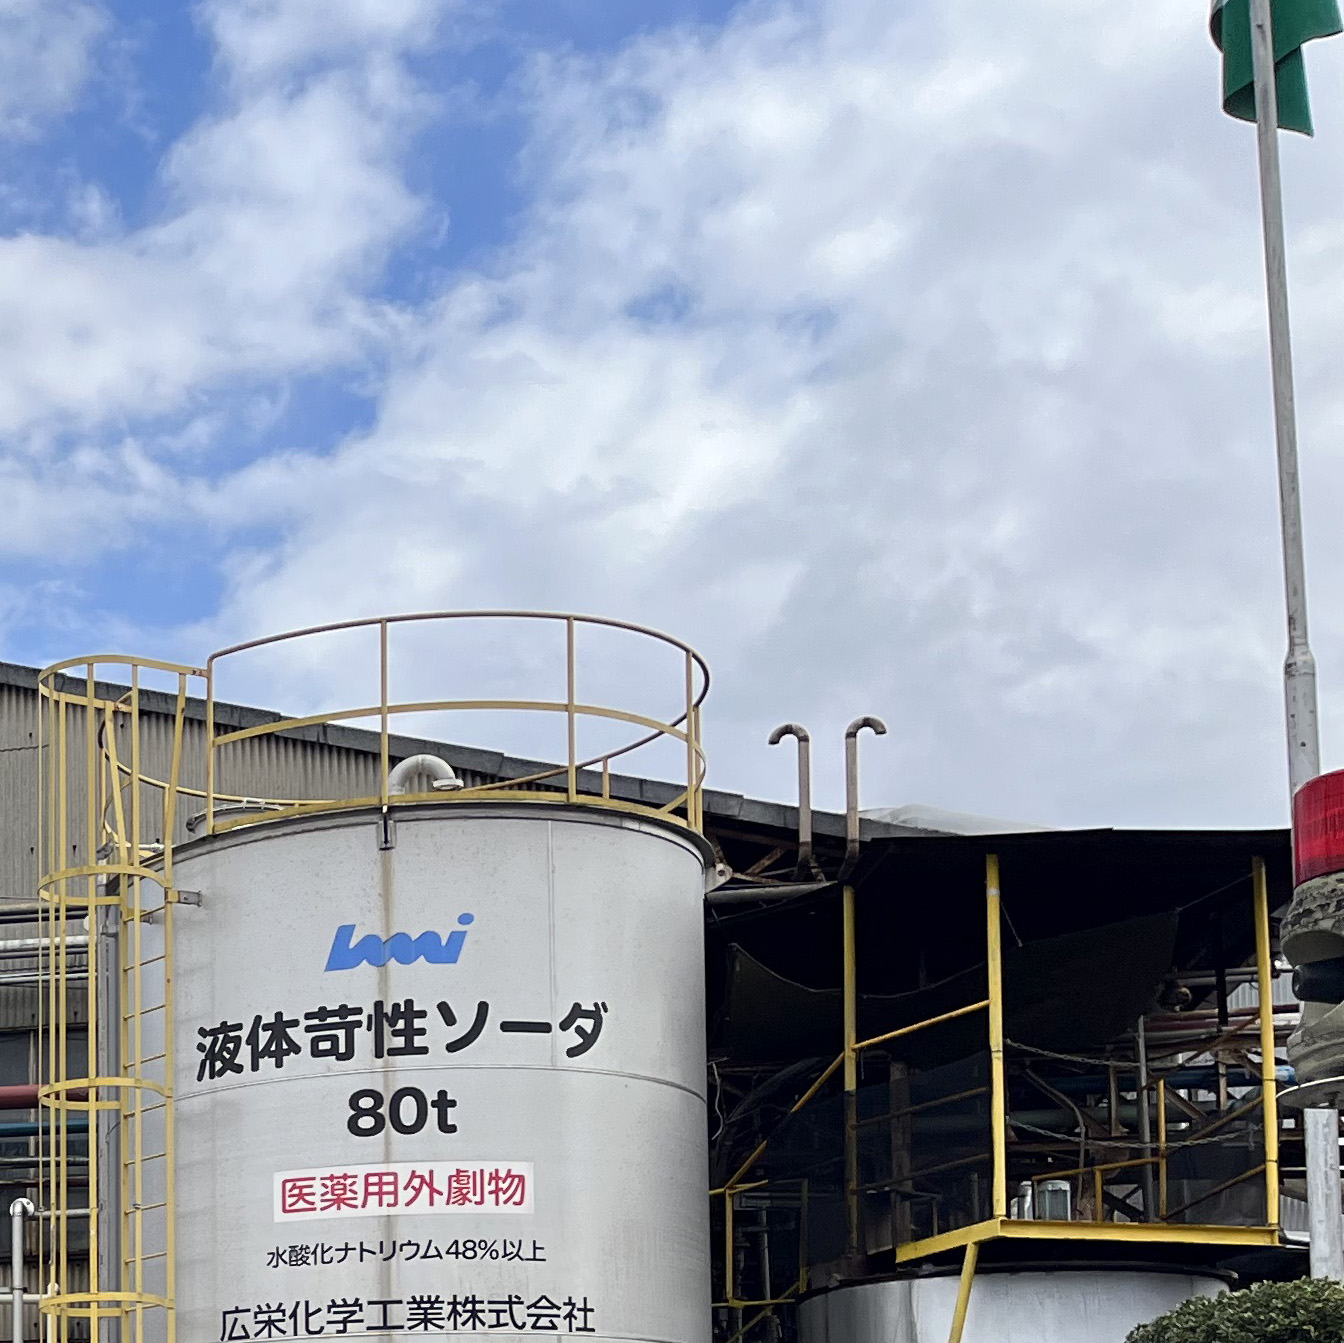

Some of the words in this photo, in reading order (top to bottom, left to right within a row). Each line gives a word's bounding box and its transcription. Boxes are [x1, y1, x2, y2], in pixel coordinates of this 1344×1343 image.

[196, 998, 608, 1082] 液体苛性ソーダ
[347, 1087, 458, 1137] 80t
[281, 1168, 527, 1214] 医薬用外劇物
[266, 1239, 547, 1268] 水酸化ナトリウム48%以上
[220, 1294, 596, 1342] 広栄化学工業株式会社
